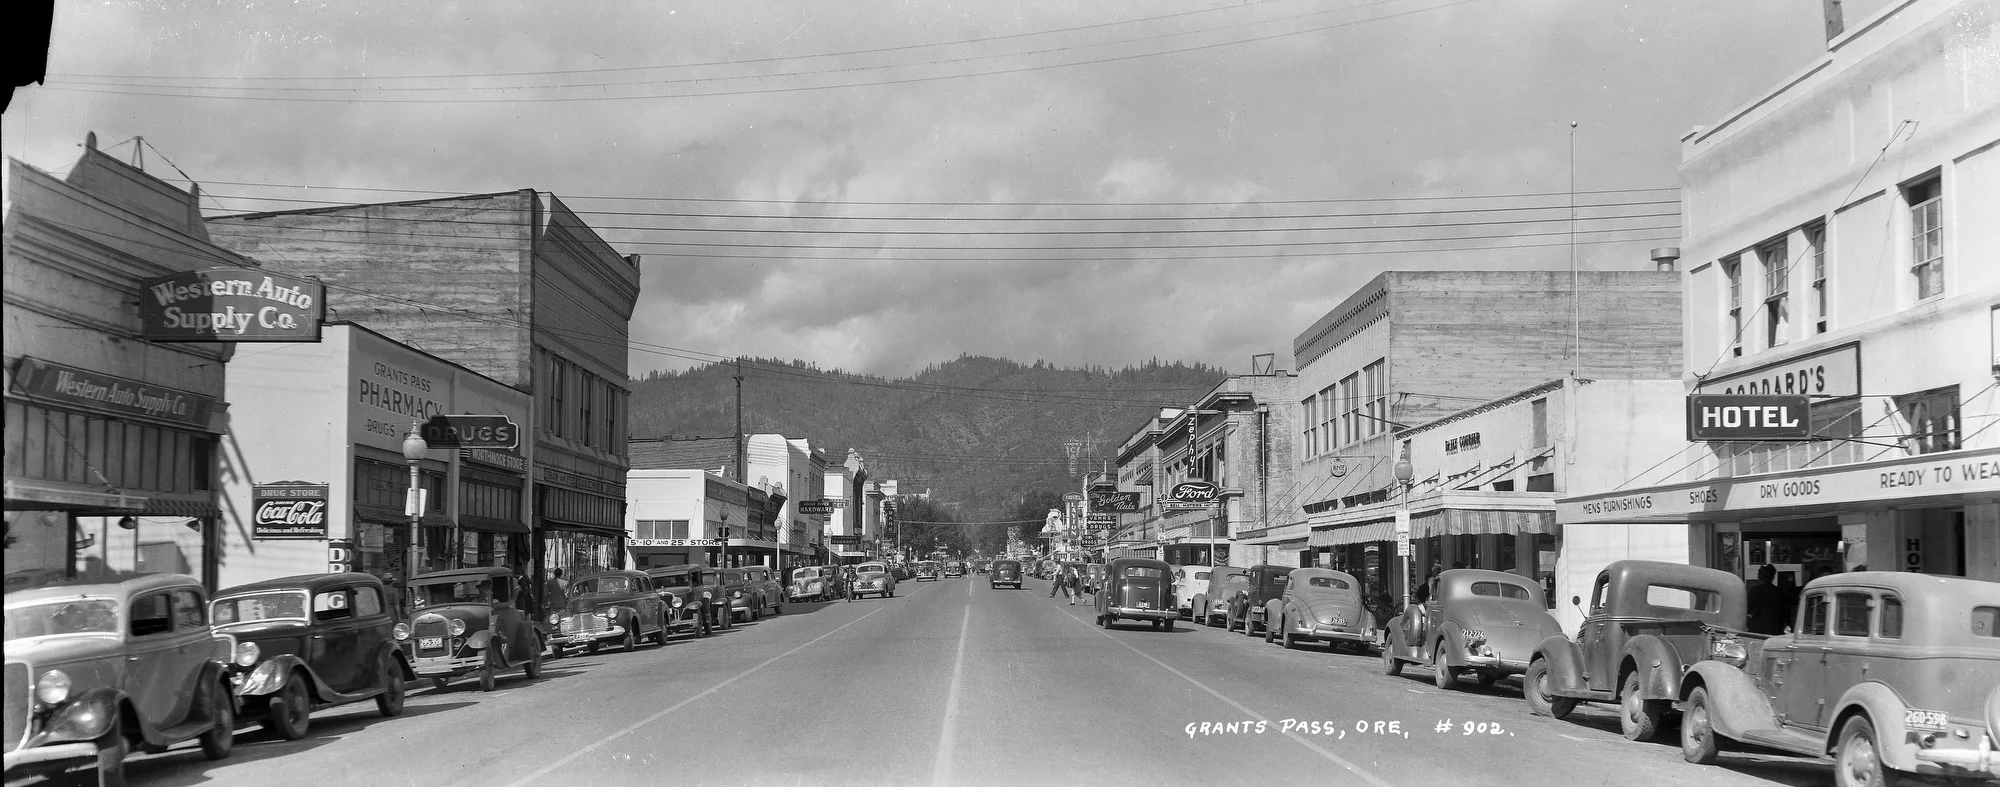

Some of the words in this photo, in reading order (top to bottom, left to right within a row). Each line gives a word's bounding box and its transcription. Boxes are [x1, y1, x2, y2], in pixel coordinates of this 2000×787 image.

[151, 274, 253, 306] Western
[253, 276, 312, 310] Auto
[163, 305, 254, 334] Supply
[258, 306, 298, 329] Co.
[374, 362, 408, 386] GRANTS
[410, 375, 431, 393] PASS
[55, 370, 107, 400] Western
[107, 382, 134, 406] Auto
[134, 388, 172, 417] Supply
[172, 395, 187, 416] Co.
[1702, 406, 1799, 428] HOTEL
[367, 418, 395, 438] DRUGS
[428, 426, 510, 442] DRUGS
[506, 456, 523, 471] STORE
[1069, 446, 1077, 474] CAFE
[1880, 468, 1926, 489] READY
[1934, 466, 1952, 483] TO
[261, 489, 286, 497] DRUG
[290, 489, 321, 497] STORE
[1175, 484, 1215, 499] Ford
[1689, 489, 1718, 505] SHOES
[1760, 483, 1779, 499] DRY
[1783, 479, 1821, 498] GOODS
[1099, 493, 1132, 507] Golden
[1582, 502, 1601, 515] MENS
[1603, 495, 1653, 513] FURNISHINGS
[255, 500, 325, 525] Coca-Cola
[293, 526, 324, 535] Refreshing
[1802, 546, 1835, 563] Sale
